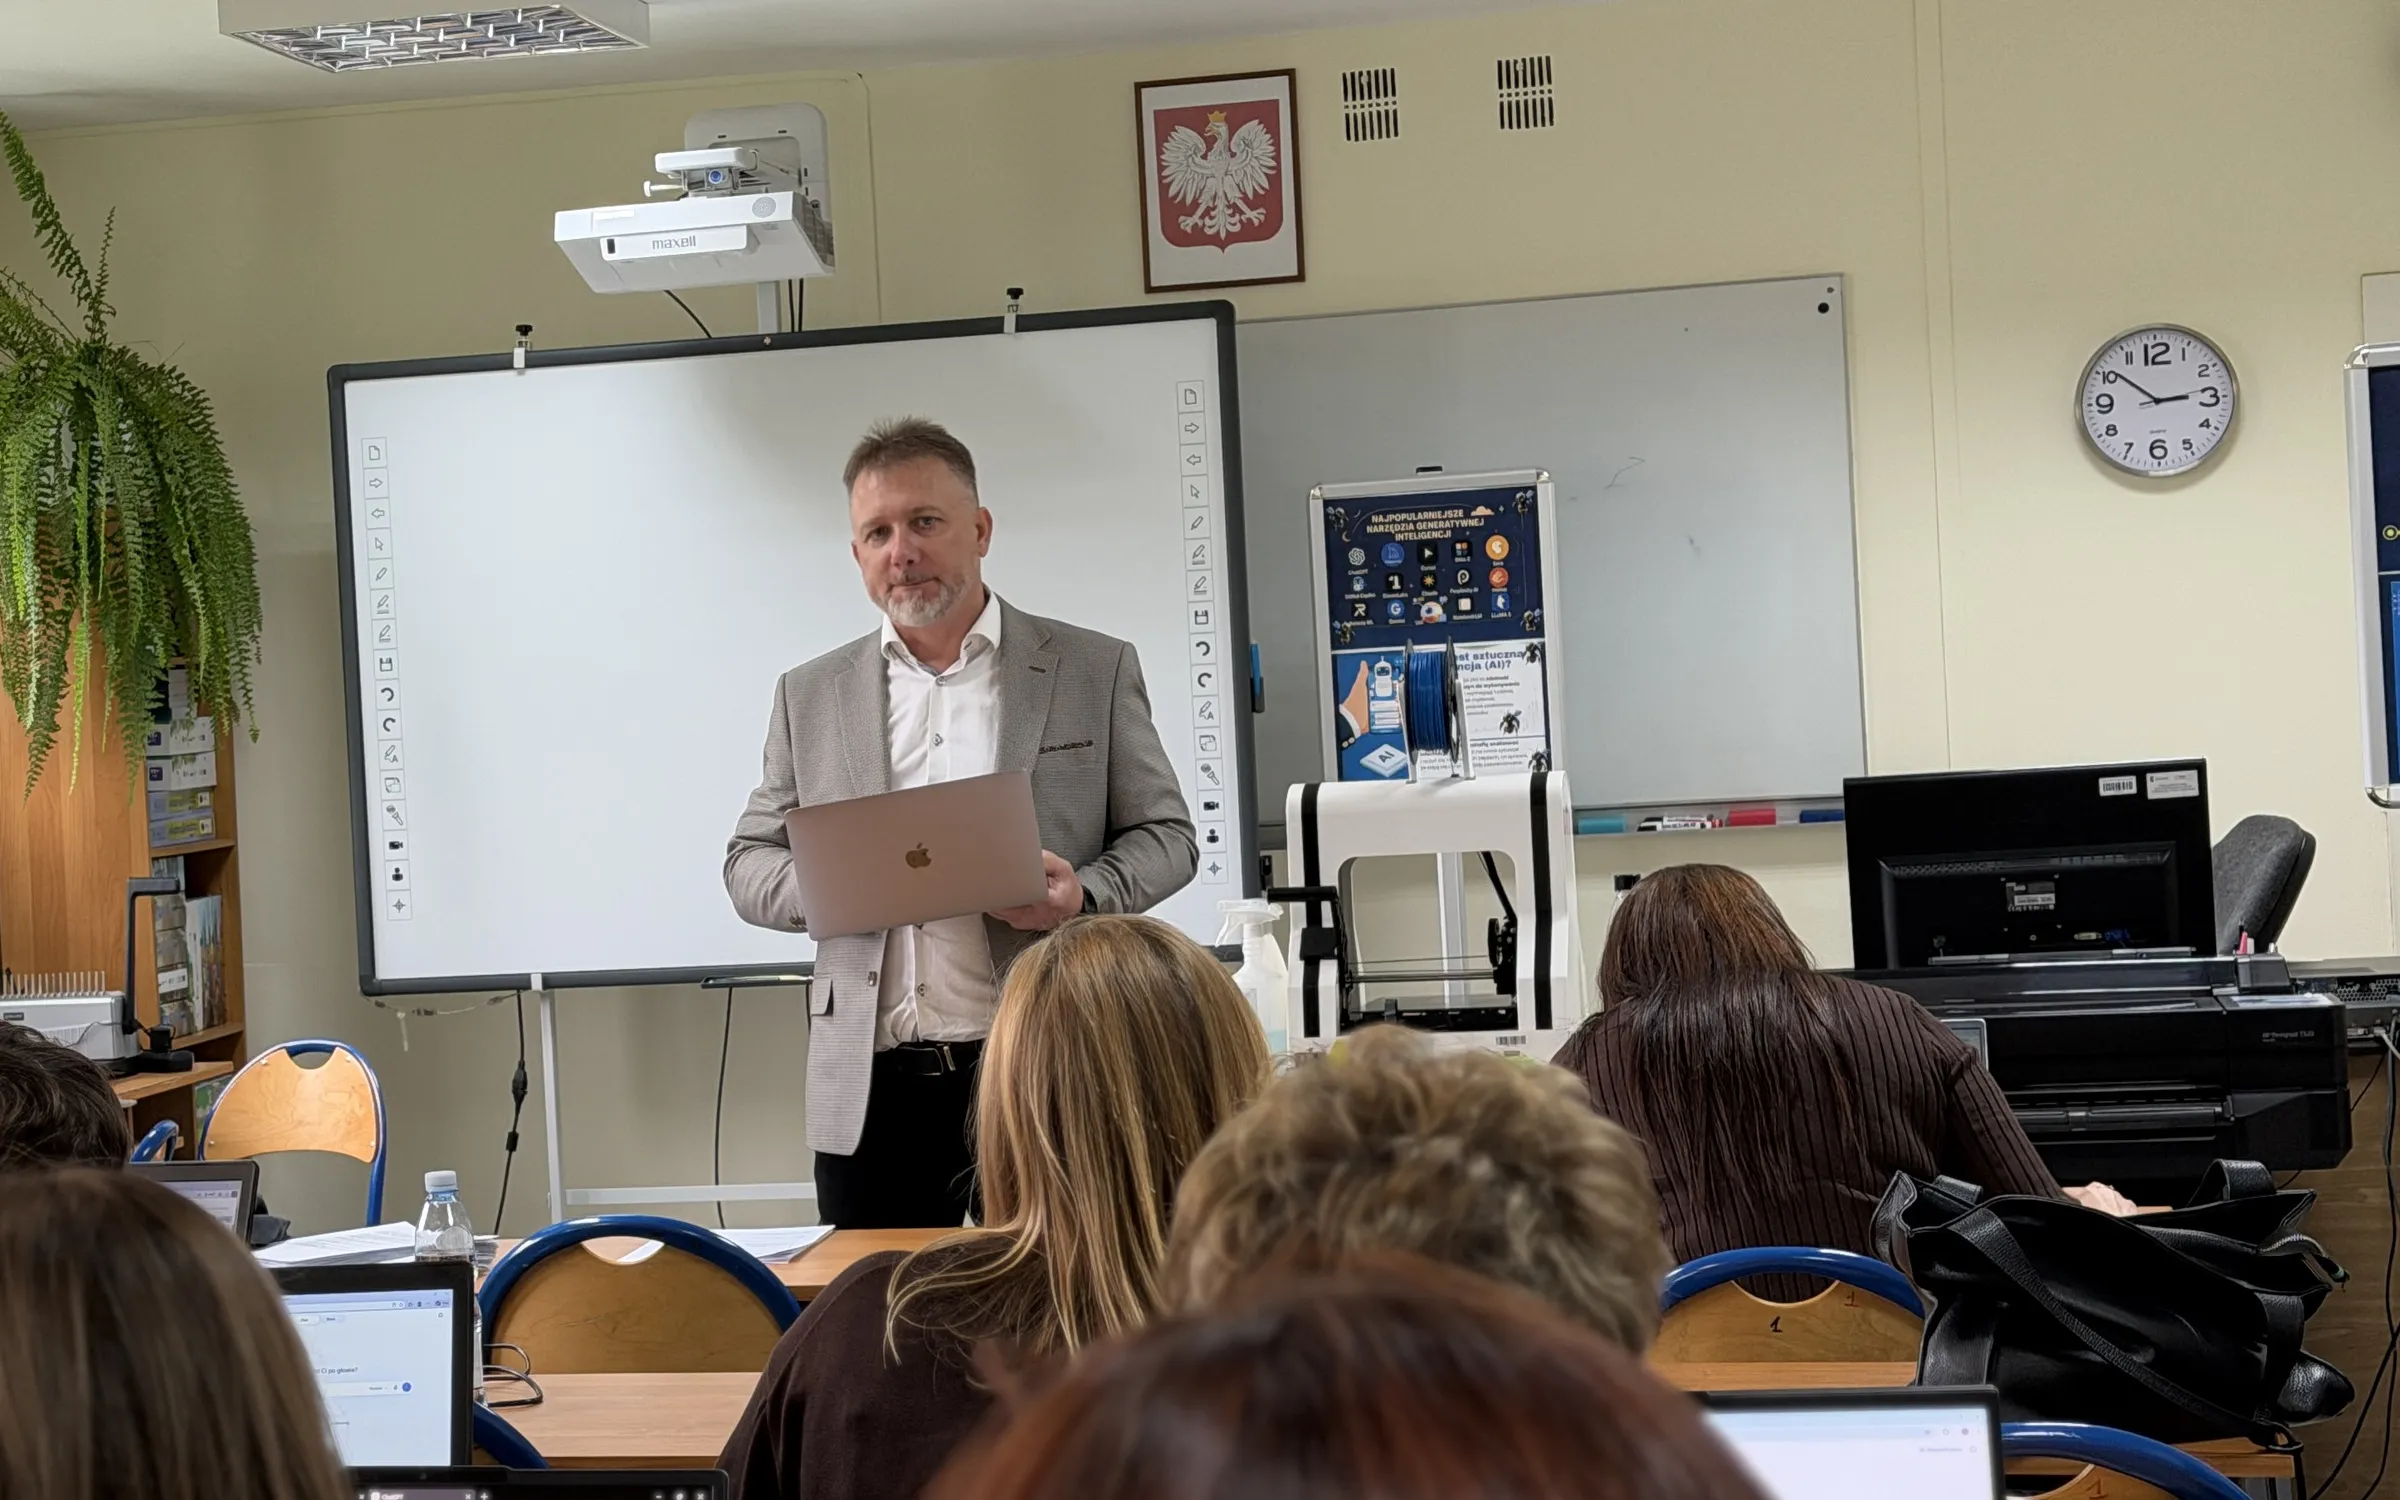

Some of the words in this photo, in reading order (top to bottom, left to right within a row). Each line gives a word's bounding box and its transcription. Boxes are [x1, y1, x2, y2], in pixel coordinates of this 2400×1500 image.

[652, 235, 696, 249] maxell
[2125, 351, 2133, 365] 11
[2144, 342, 2171, 366] 12
[2181, 347, 2186, 361] 1
[2102, 370, 2118, 384] 10
[2198, 364, 2210, 377] 2
[2096, 393, 2114, 414] 9
[2199, 386, 2220, 407] 3
[2105, 424, 2118, 437] 8
[2198, 418, 2211, 429] 4
[2124, 442, 2134, 455] 7
[2149, 439, 2168, 460] 6
[2182, 438, 2193, 450] 5
[1371, 509, 1464, 523] NAJPOPULARNIEJSZE
[1366, 523, 1414, 534] NARZĘDZIA
[1416, 518, 1485, 530] GENERATYWNEJ
[1395, 530, 1452, 541] INTELIGENCJI
[1485, 660, 1512, 671] (AI)?
[1377, 750, 1396, 764] AI
[1770, 1315, 1783, 1332] 1
